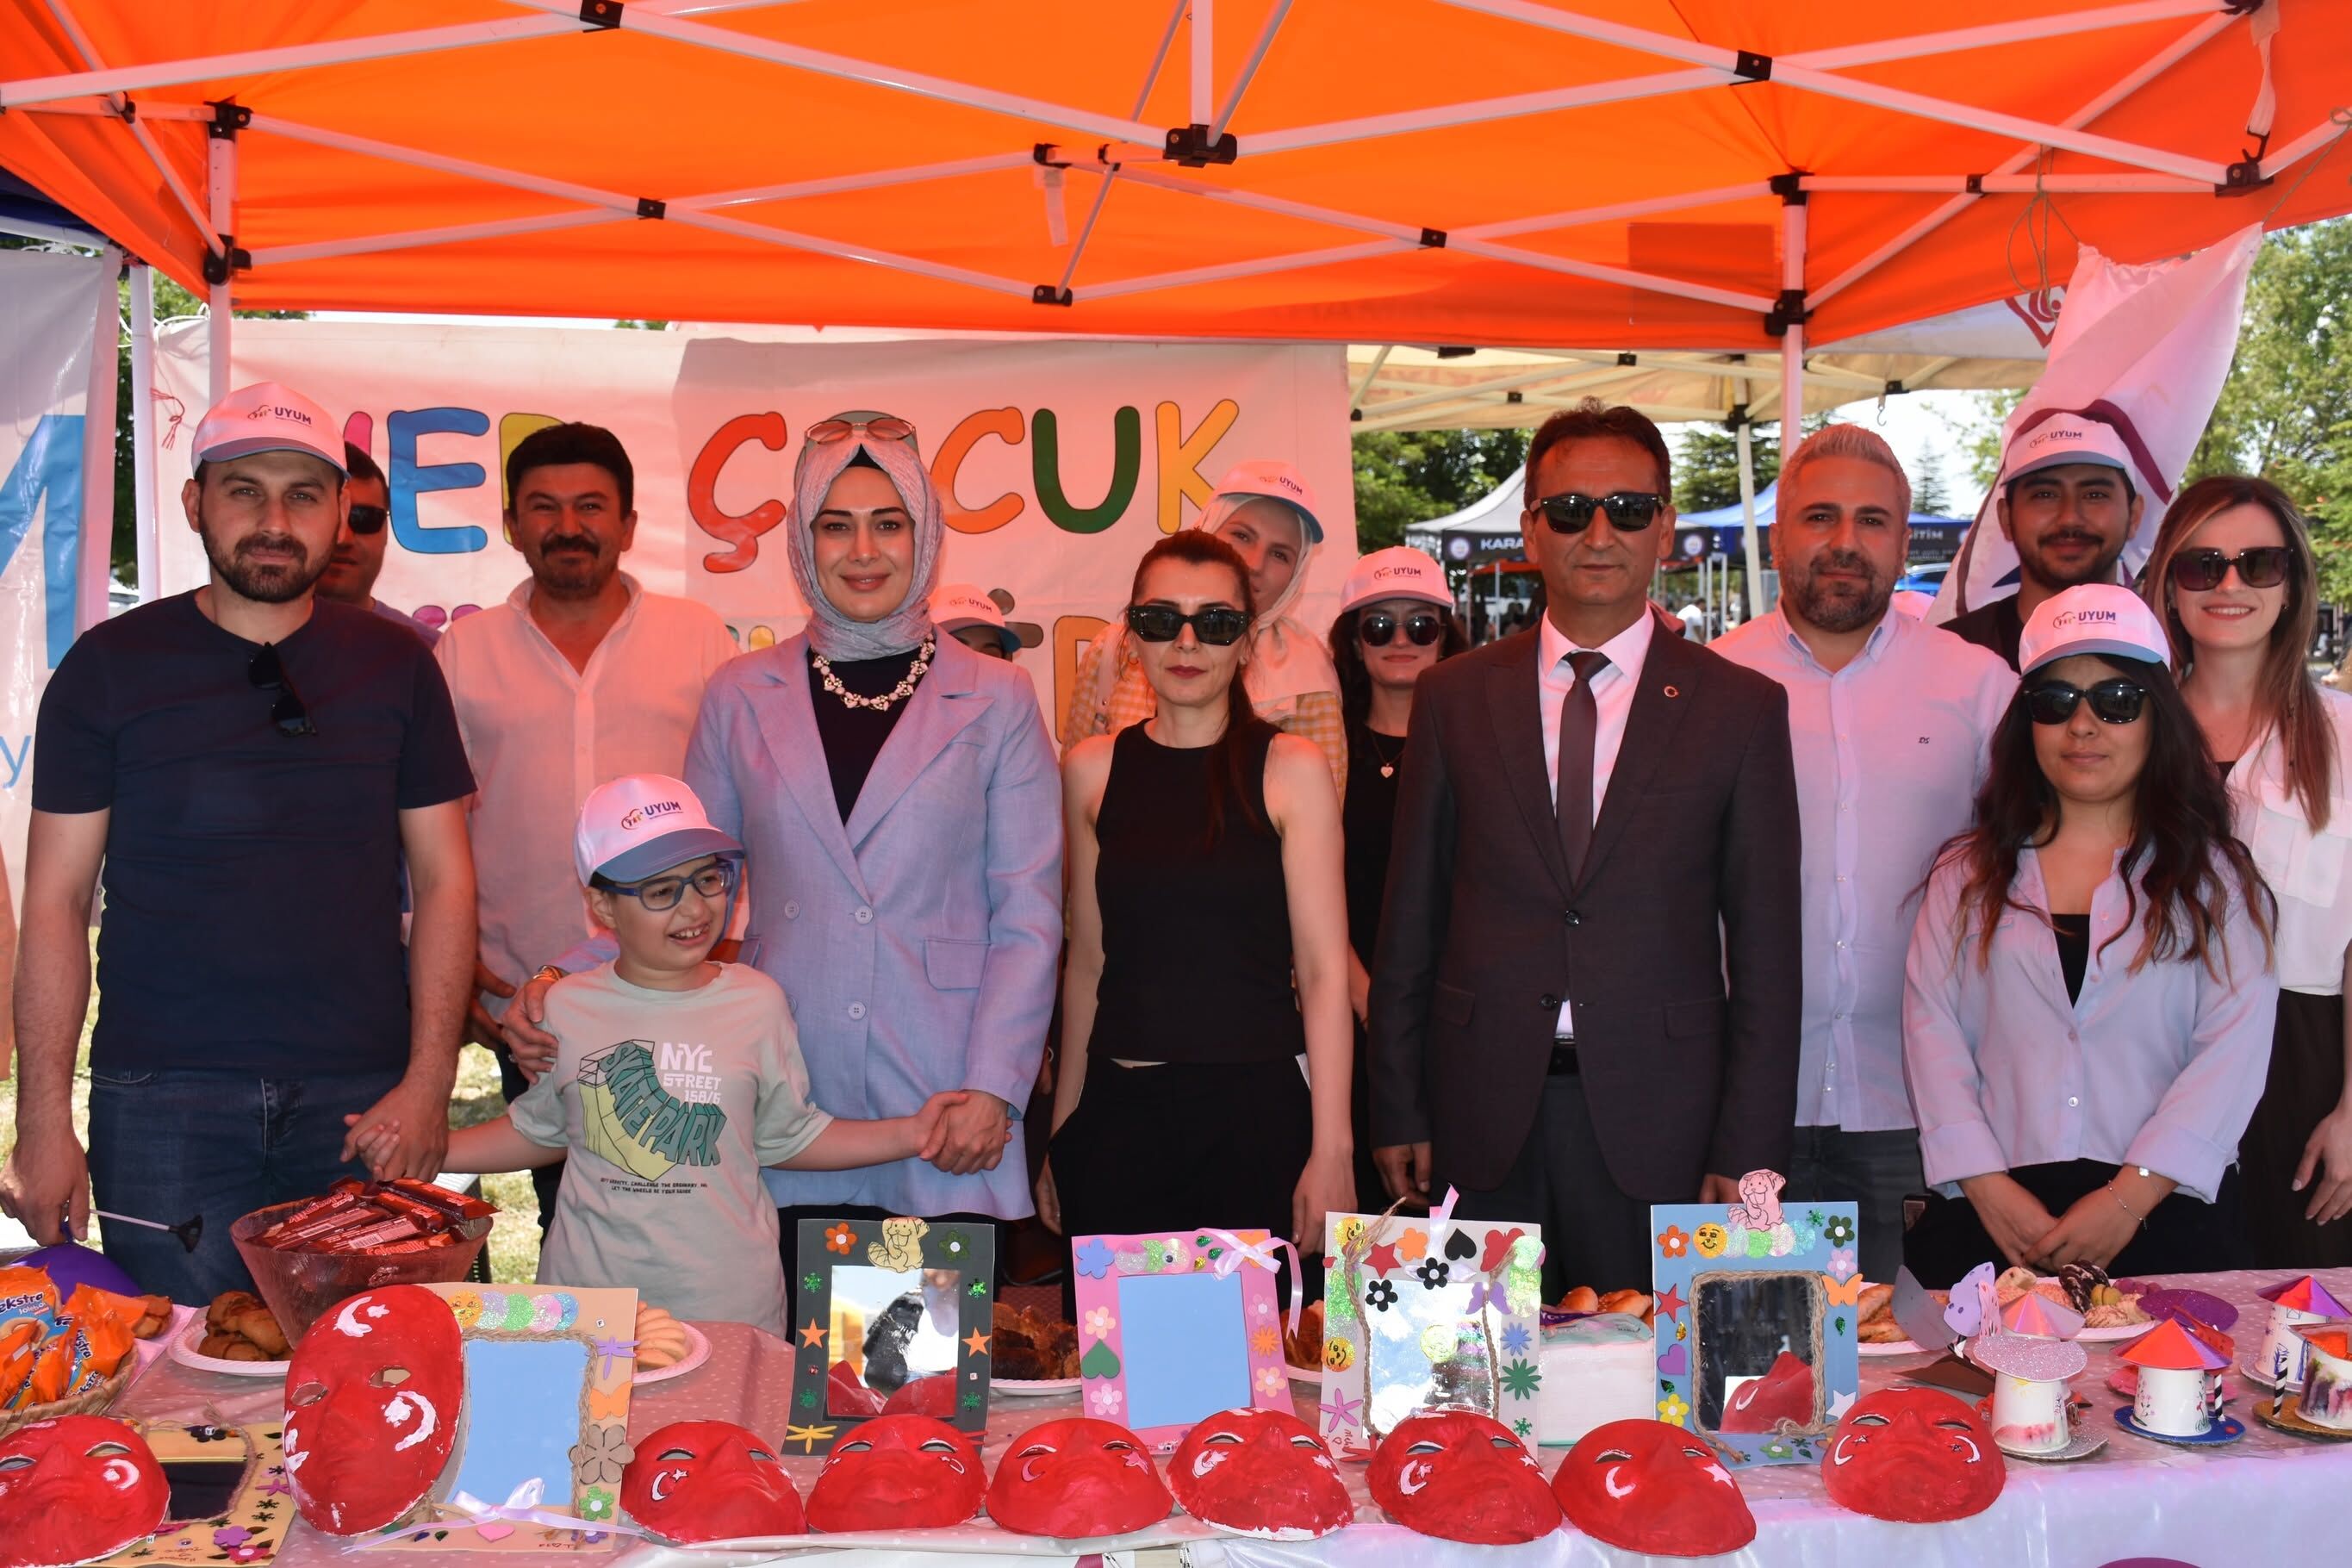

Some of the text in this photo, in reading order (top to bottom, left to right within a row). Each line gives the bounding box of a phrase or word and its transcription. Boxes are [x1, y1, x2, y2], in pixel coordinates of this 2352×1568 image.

[275, 407, 312, 425] UYUM
[2050, 430, 2082, 439] UYUM
[687, 397, 1240, 573] ÇCUK
[1279, 476, 1303, 495] UYUM
[1393, 567, 1422, 576] UYUM
[968, 598, 992, 613] UYUM
[2078, 611, 2116, 621] UYUM
[644, 801, 681, 816] UYUM
[660, 1042, 712, 1073] NYC
[663, 1073, 722, 1091] STREET
